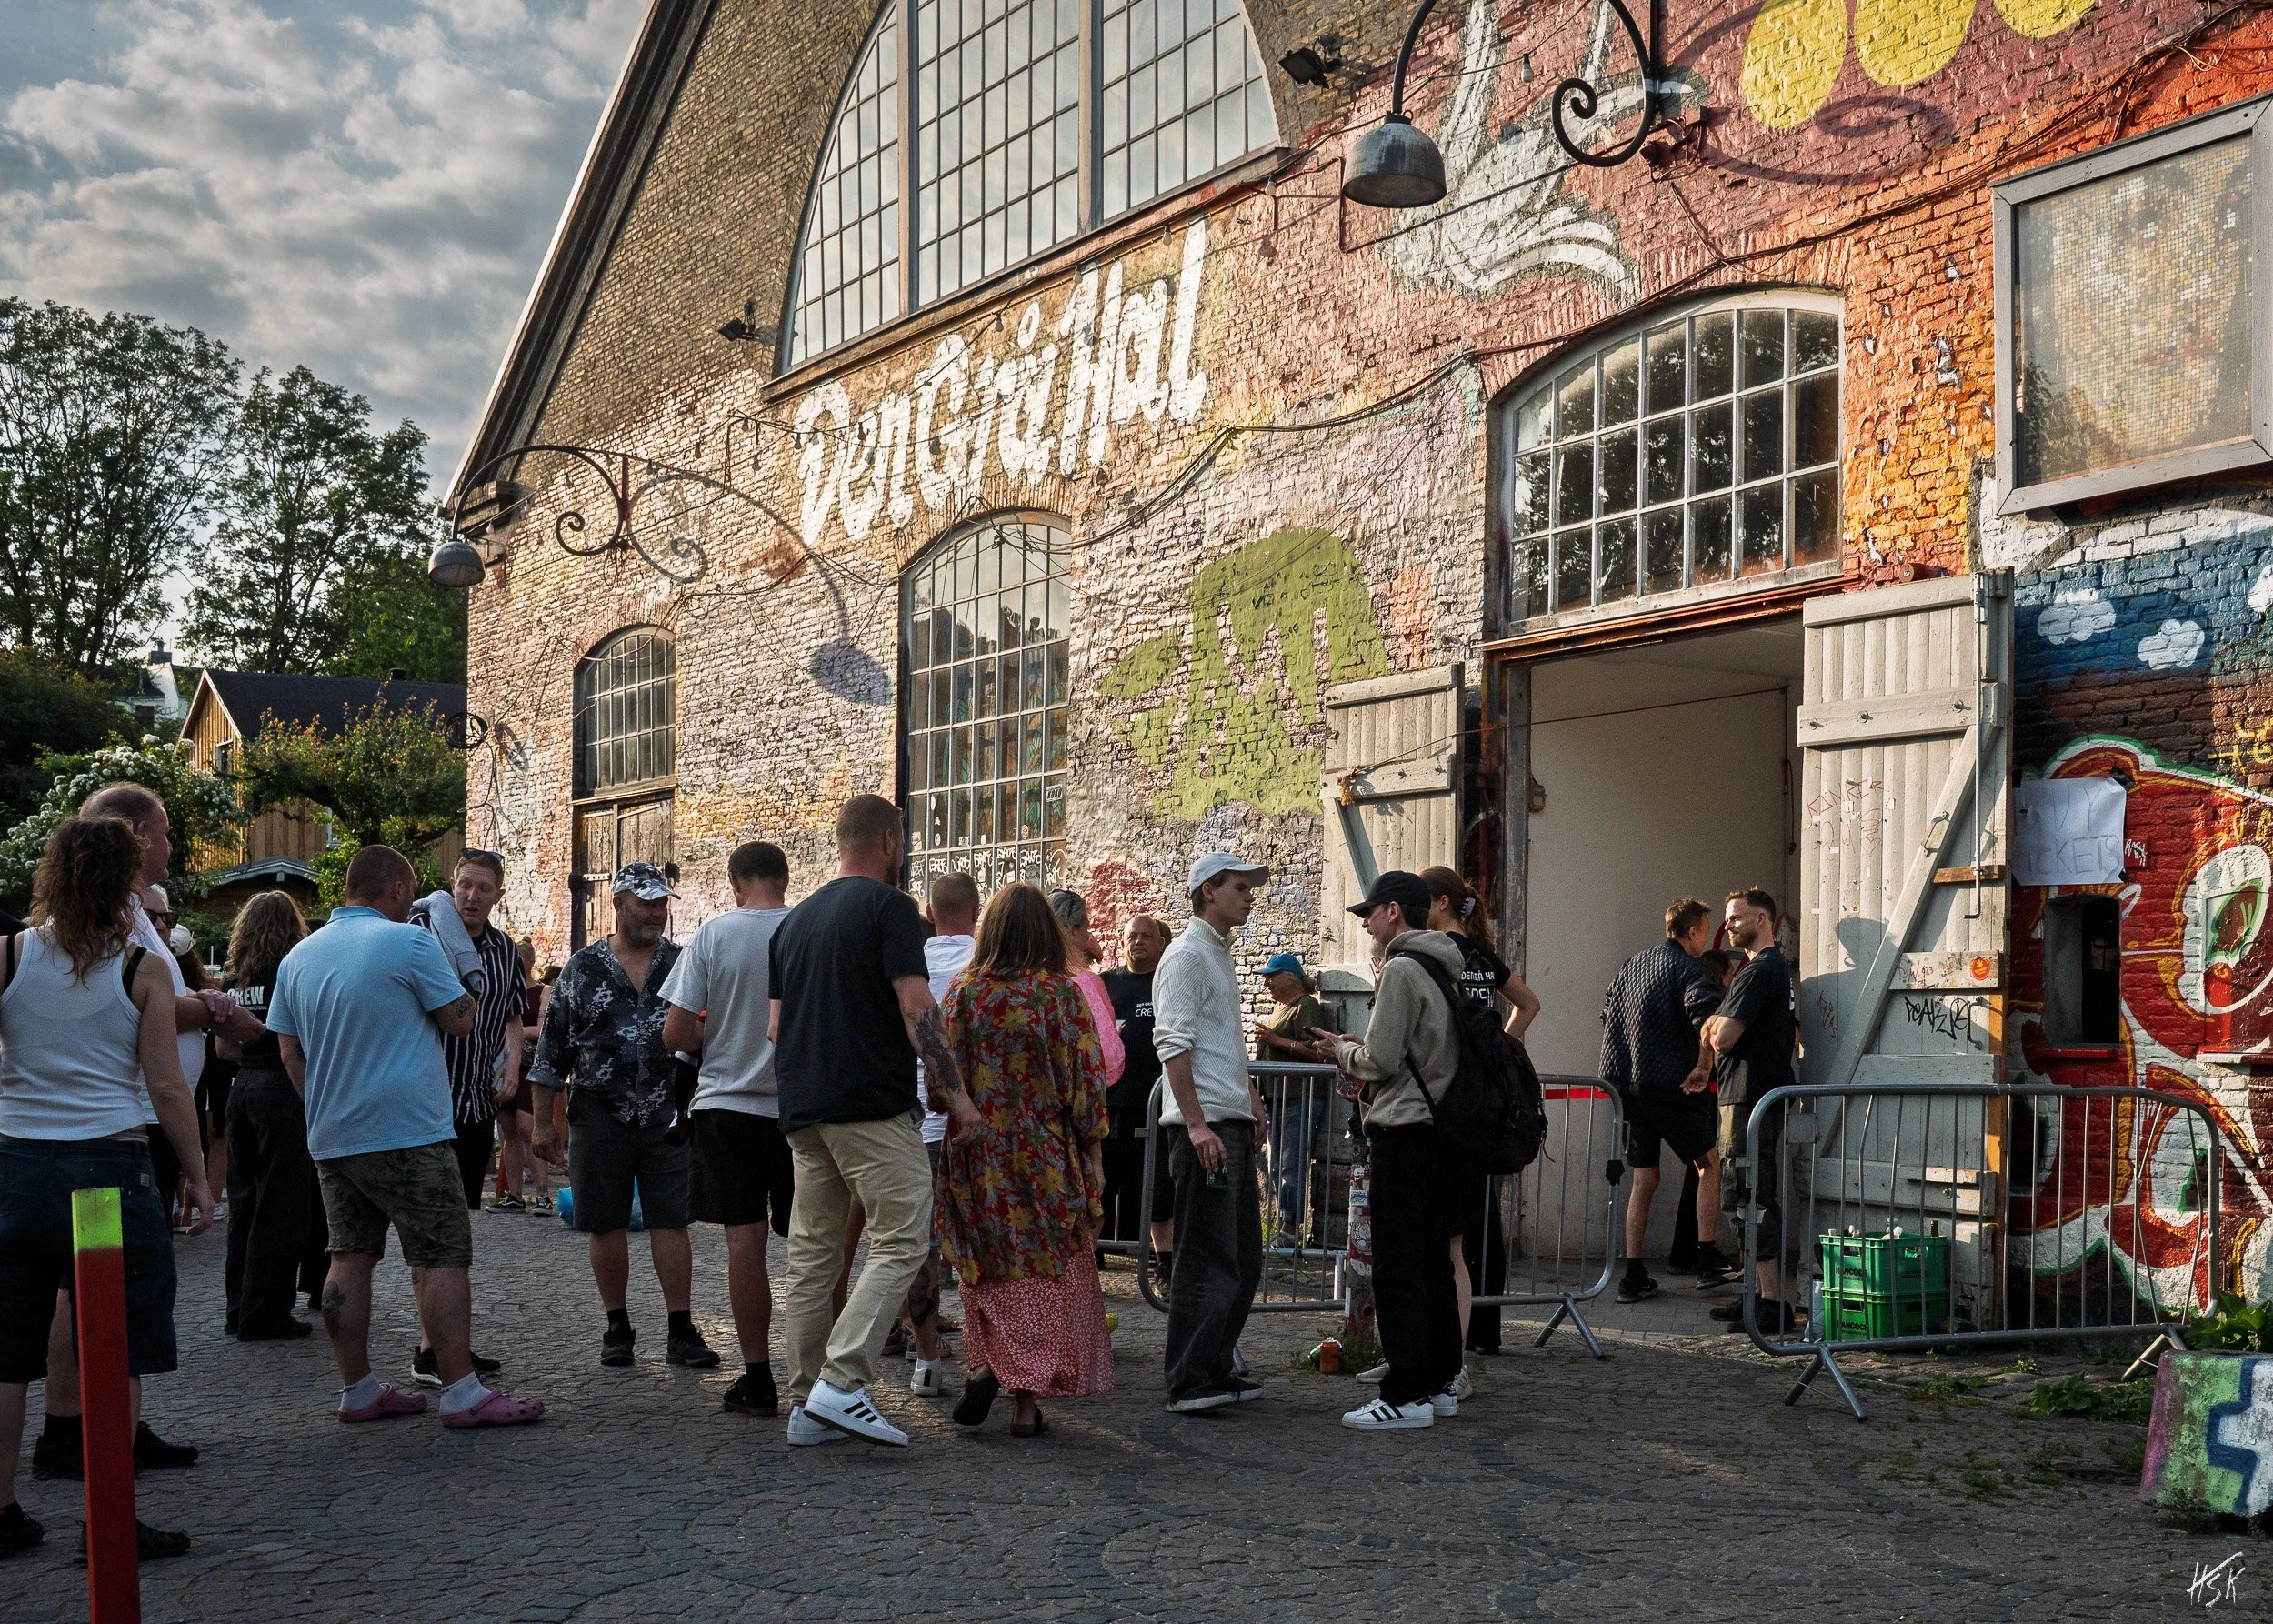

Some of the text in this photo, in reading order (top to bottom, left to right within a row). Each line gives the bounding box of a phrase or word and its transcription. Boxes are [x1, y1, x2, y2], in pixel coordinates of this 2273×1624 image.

[794, 380, 911, 546] Den
[1058, 218, 1207, 478] Hal
[227, 986, 265, 1006] CREW
[1135, 1007, 1153, 1017] CRE
